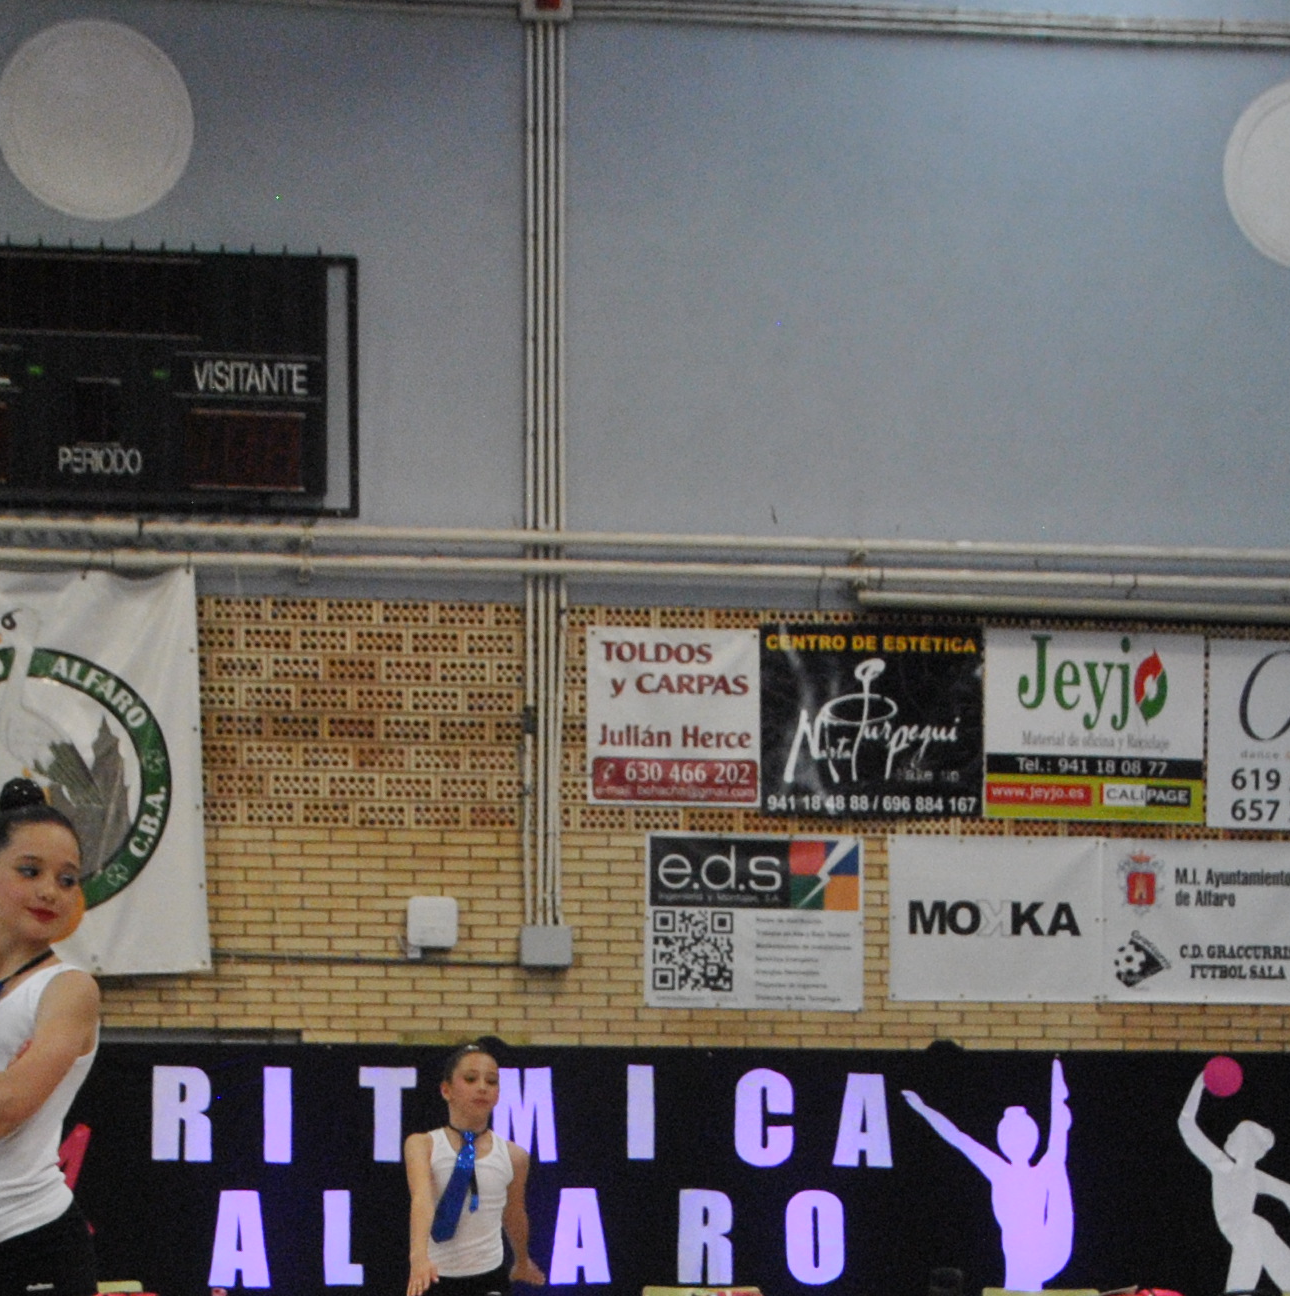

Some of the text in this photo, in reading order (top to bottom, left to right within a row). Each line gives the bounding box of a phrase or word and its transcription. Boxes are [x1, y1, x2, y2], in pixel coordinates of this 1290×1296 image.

[193, 360, 309, 395] VISITANTE
[57, 446, 143, 475] PERIODO
[600, 640, 714, 664] TOLDOS
[766, 634, 846, 650] CENTRO
[852, 635, 878, 651] DE
[50, 656, 148, 728] ALFARO
[610, 673, 751, 698] y CARPAS
[598, 723, 752, 749] Julián Herce
[625, 761, 751, 784] 630 466 202
[1058, 758, 1089, 774] 941
[1097, 759, 1116, 774] 18
[1121, 760, 1143, 775] 08
[1148, 761, 1168, 776] 77
[1231, 768, 1281, 791] 619
[767, 795, 796, 811] 941
[802, 795, 821, 811] 18
[990, 785, 1085, 801] www.jeyjo.es
[1231, 799, 1280, 822] 657
[1174, 867, 1201, 885] M.I.
[1174, 889, 1236, 907] de Alfaro
[1179, 943, 1204, 959] C.D.
[1190, 964, 1287, 980] FUTBOL SALA
[207, 1187, 846, 1289] ALARO
